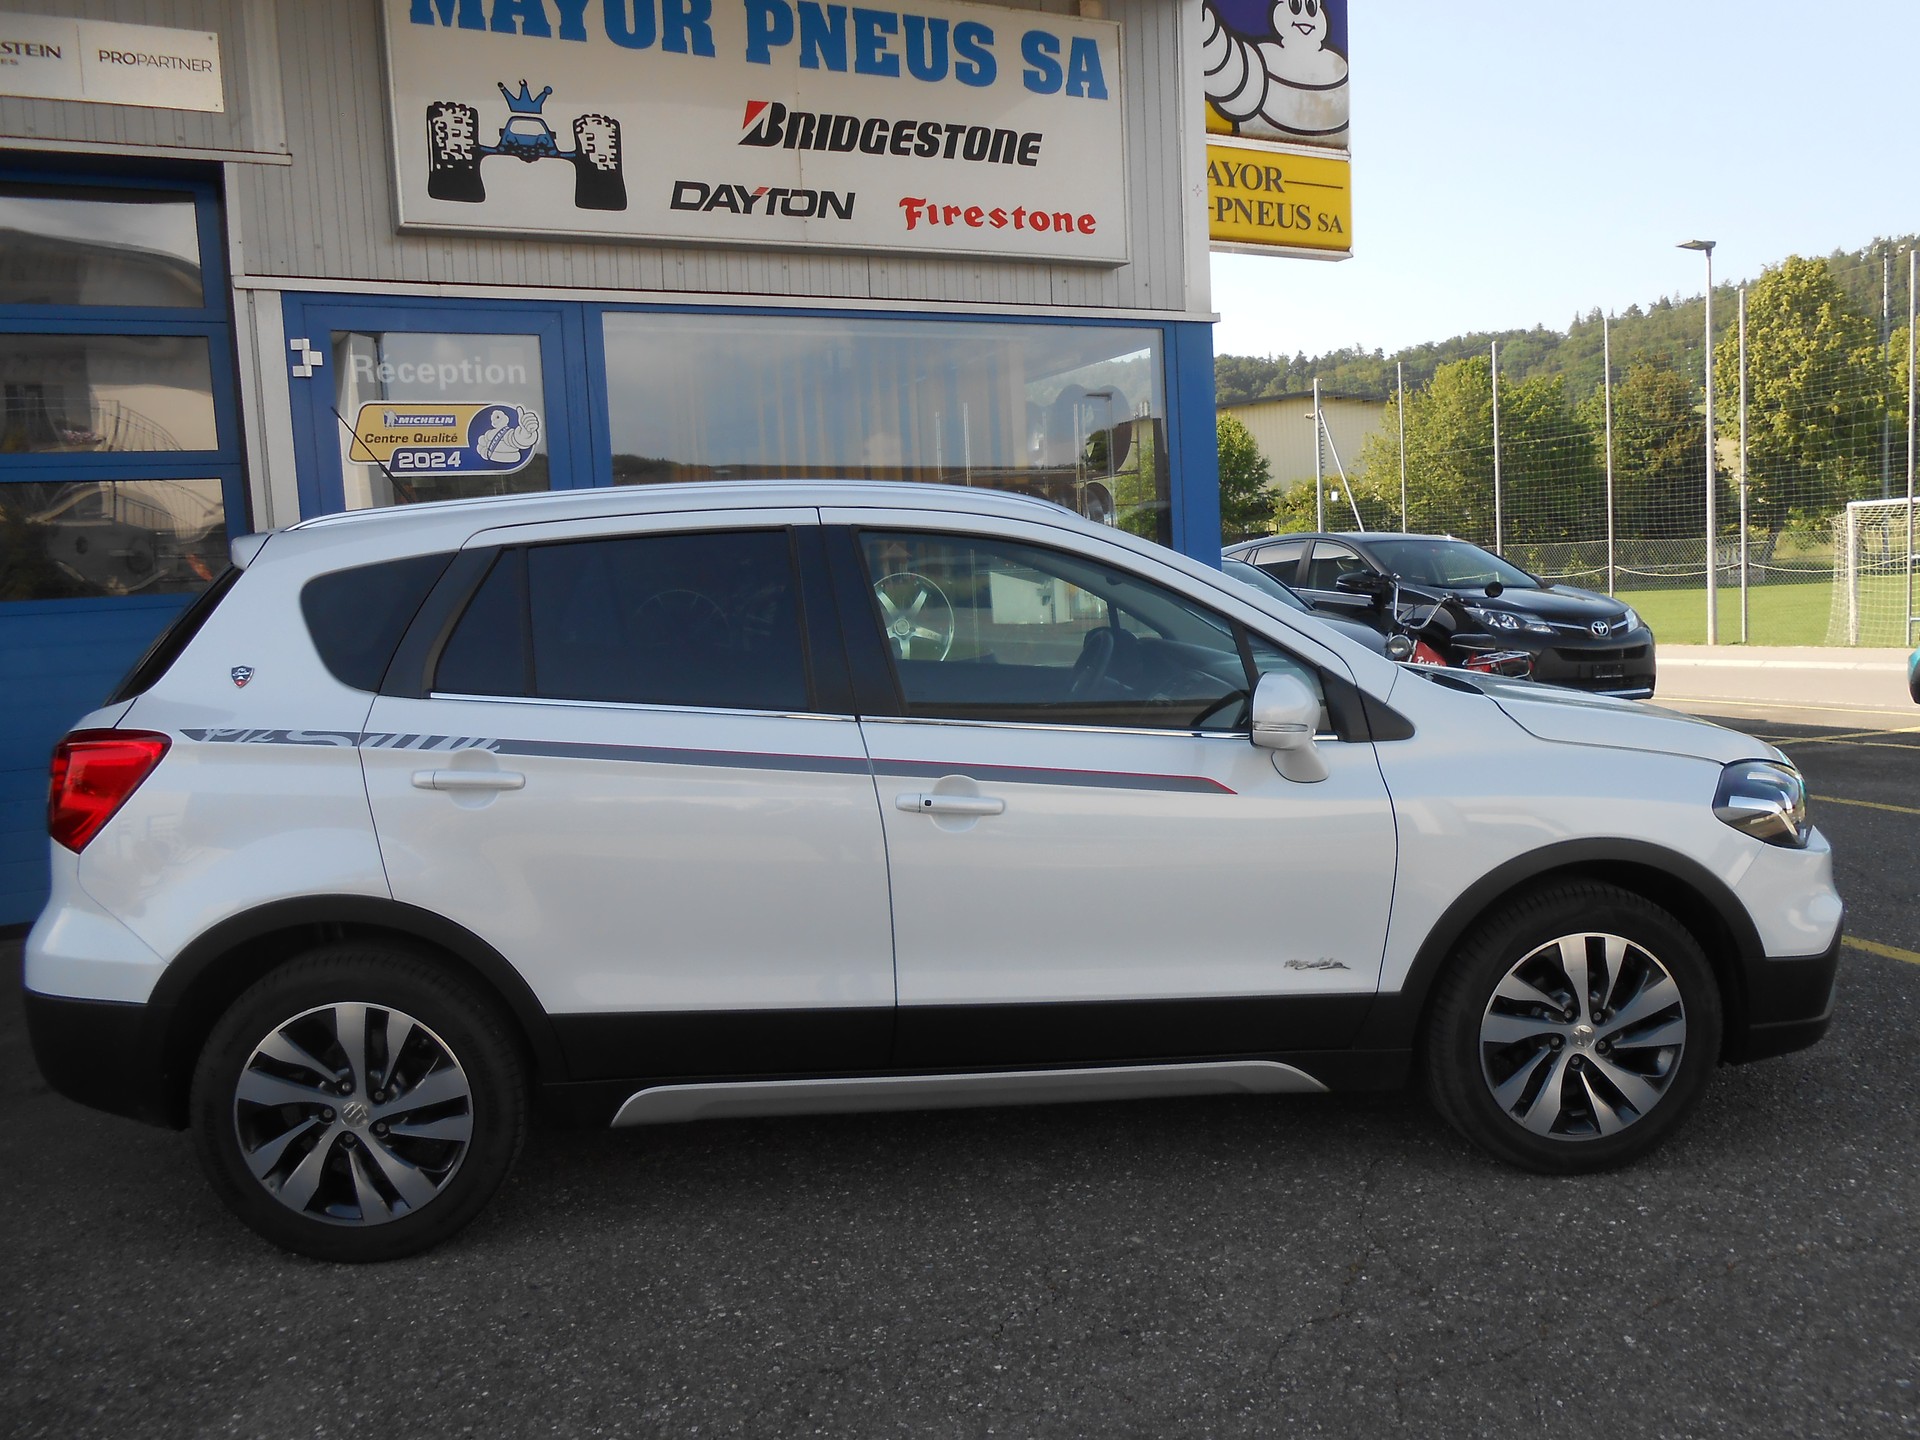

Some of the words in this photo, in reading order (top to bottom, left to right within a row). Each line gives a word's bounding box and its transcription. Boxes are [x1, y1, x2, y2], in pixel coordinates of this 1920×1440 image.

[98, 49, 213, 73] PROPARTNER
[744, 0, 998, 88] PNEUS
[1021, 30, 1109, 100] SA
[738, 100, 1043, 167] BRIDGESTONE
[670, 180, 856, 220] DAYTON
[899, 196, 1097, 235] Firestone
[1317, 212, 1344, 234] SA
[351, 354, 527, 391] Réception
[398, 416, 454, 424] MICHELIN
[364, 433, 409, 444] Centre
[413, 432, 458, 443] Qualité
[398, 451, 461, 468] 2024
